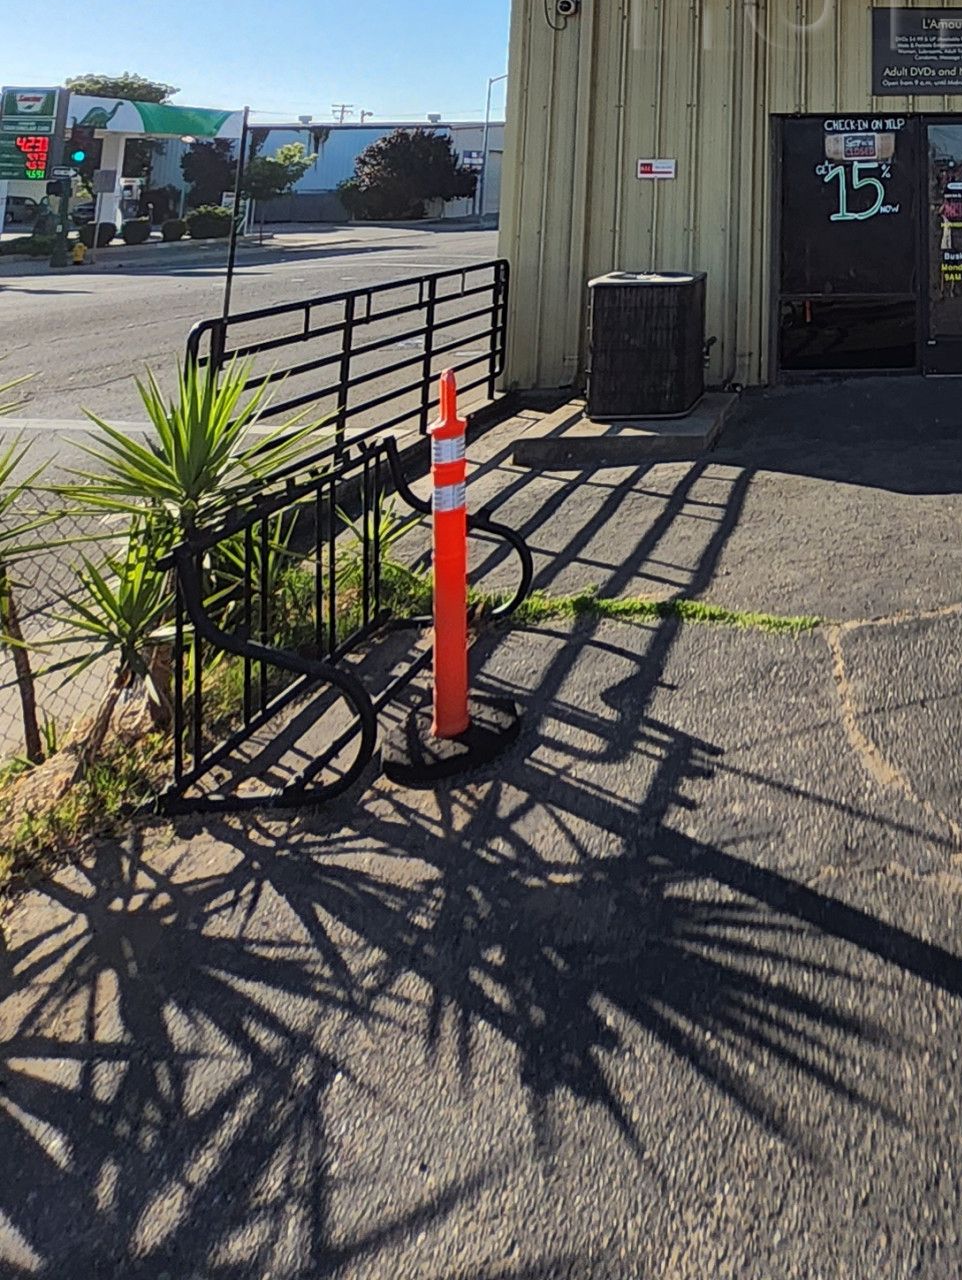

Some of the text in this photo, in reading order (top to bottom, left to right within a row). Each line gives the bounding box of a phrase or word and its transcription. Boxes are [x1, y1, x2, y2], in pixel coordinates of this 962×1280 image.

[883, 67, 908, 77] Adult
[910, 67, 936, 77] DVDs
[938, 67, 957, 77] and
[871, 119, 883, 130] ON
